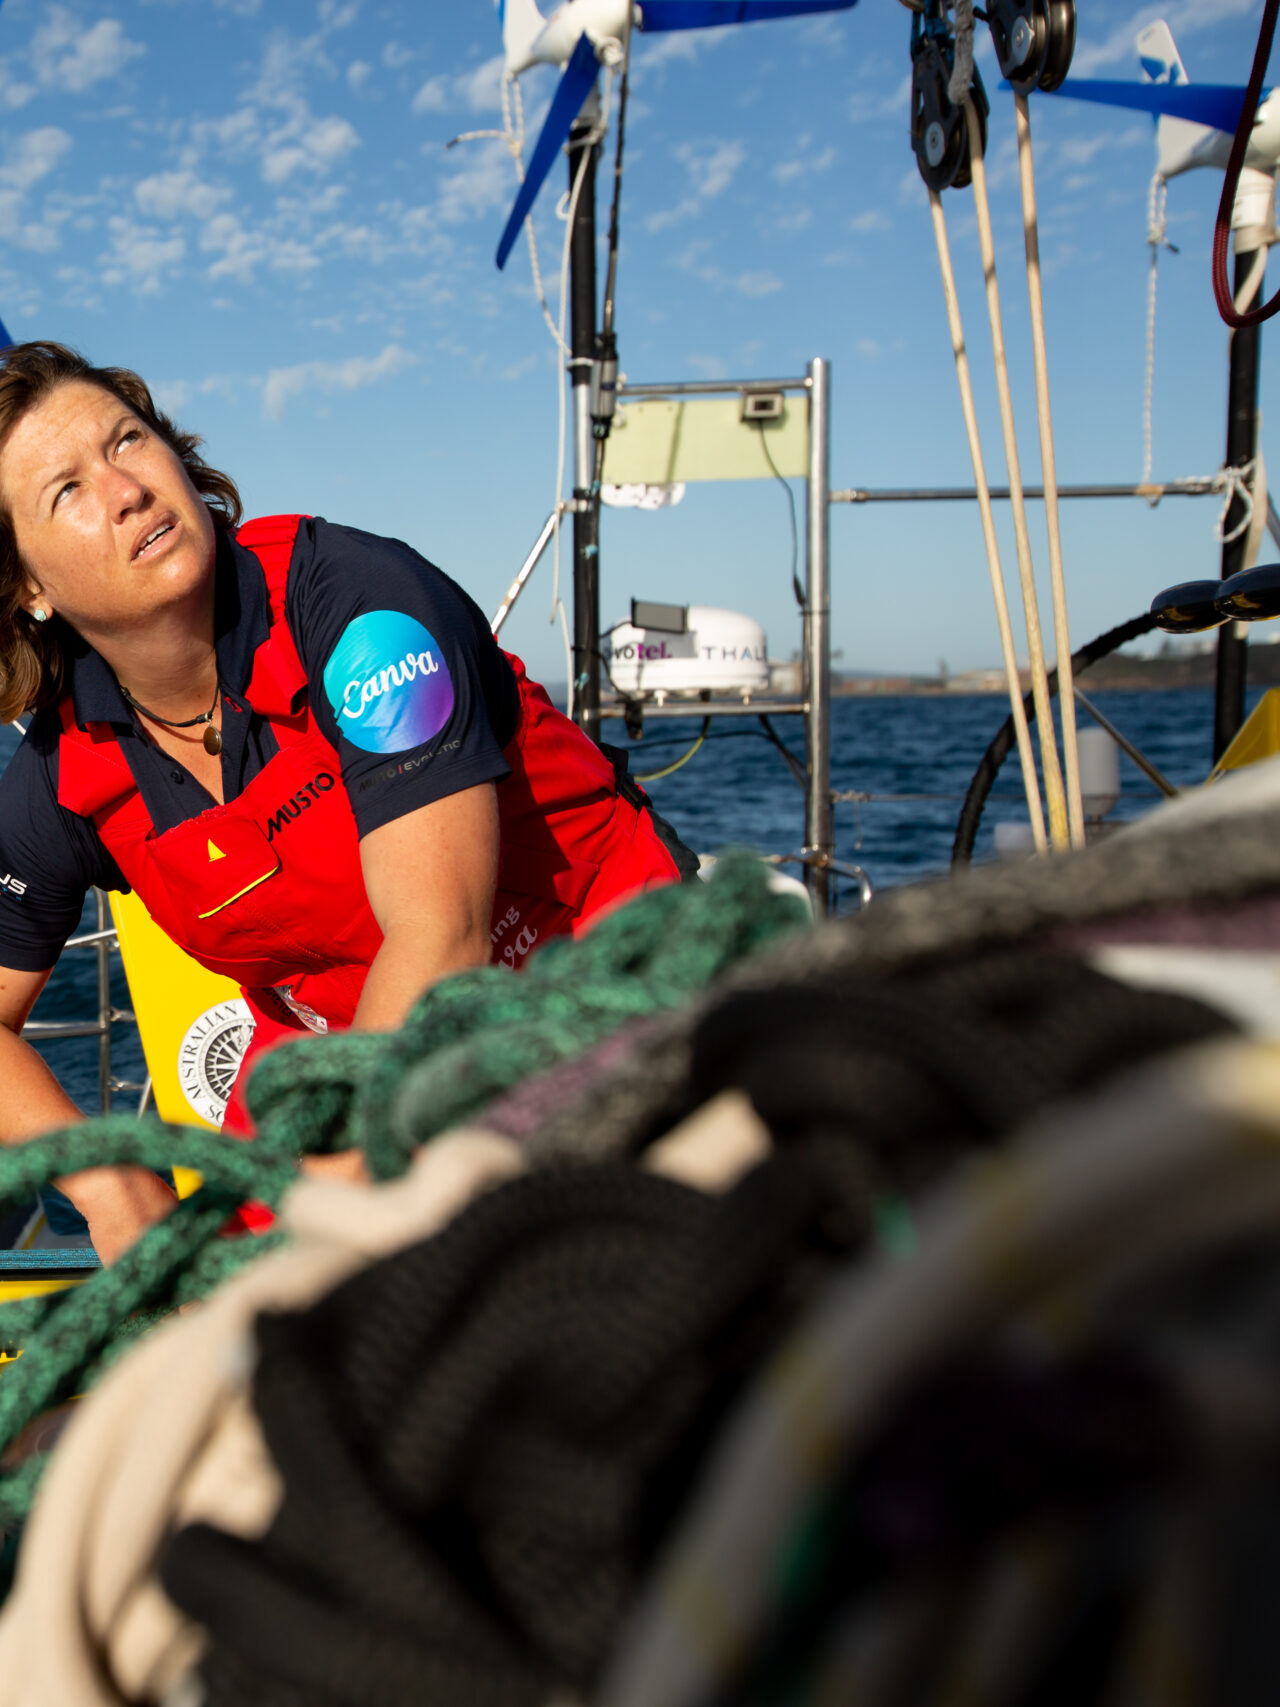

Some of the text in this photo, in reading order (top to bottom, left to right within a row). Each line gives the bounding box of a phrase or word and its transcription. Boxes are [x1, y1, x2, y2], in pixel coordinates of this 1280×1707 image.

[342, 650, 439, 719] Canva
[605, 640, 672, 661] votel.
[267, 772, 335, 842] MUSTO
[182, 1003, 238, 1101] AUSTRALIAN
